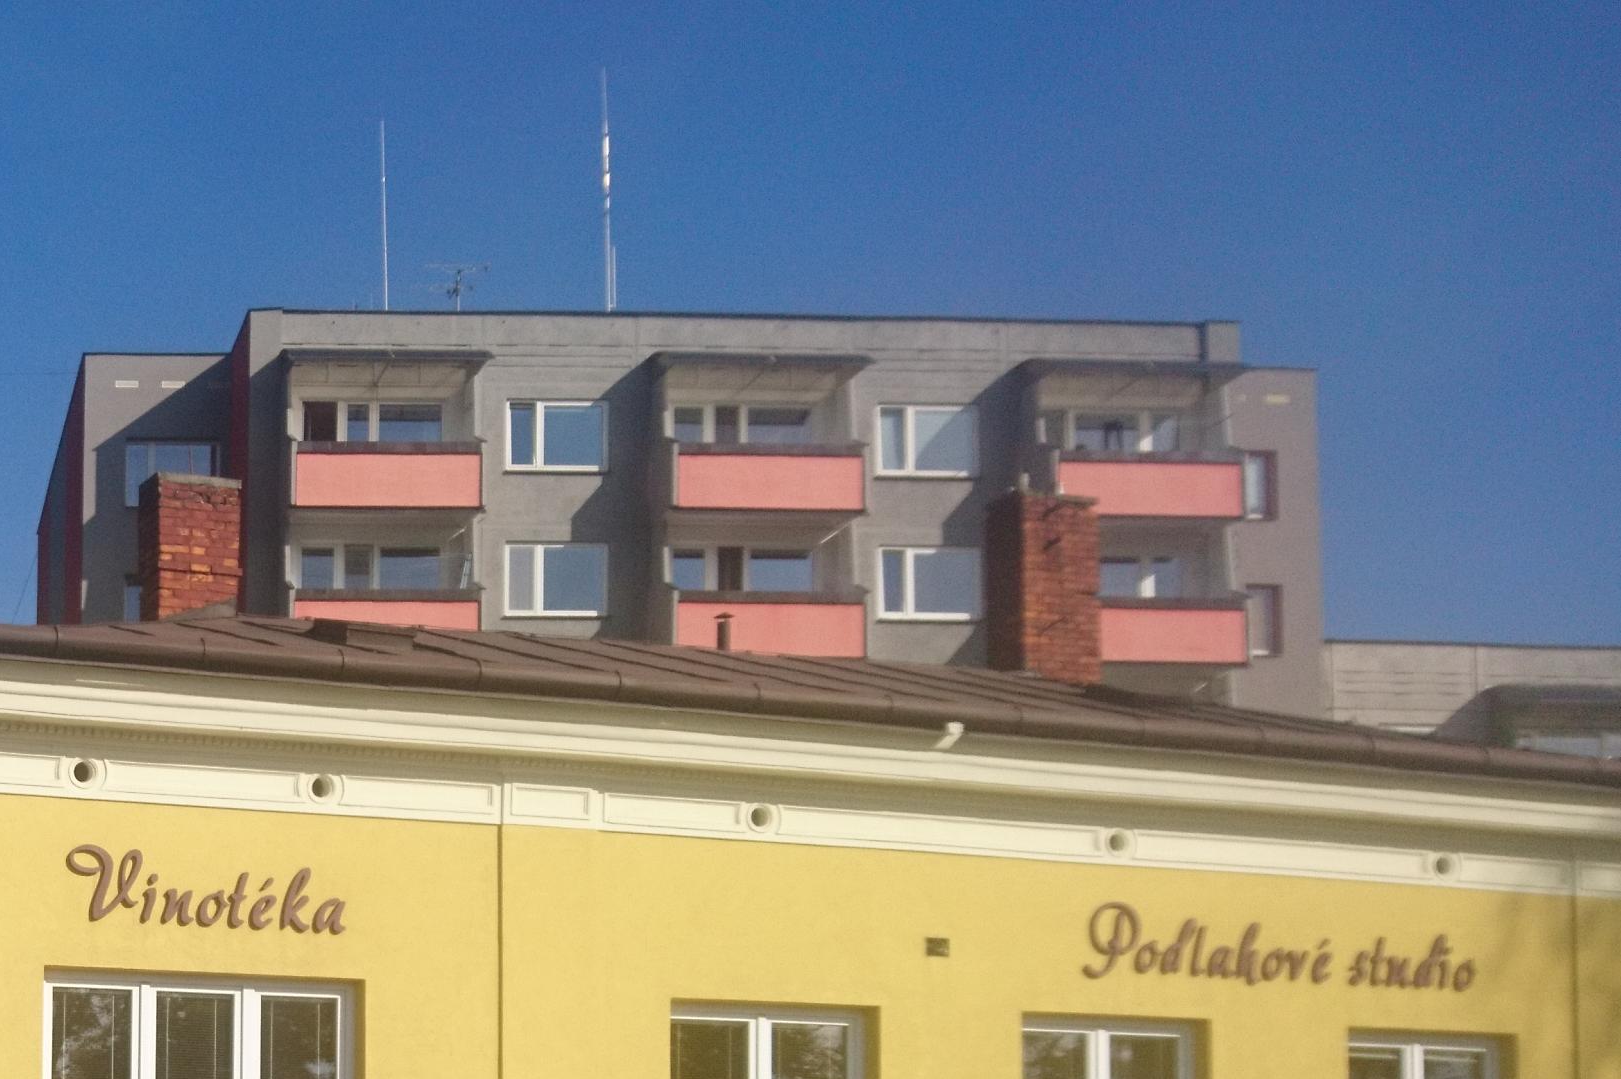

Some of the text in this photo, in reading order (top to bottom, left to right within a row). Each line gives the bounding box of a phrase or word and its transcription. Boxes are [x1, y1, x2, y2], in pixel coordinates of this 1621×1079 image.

[65, 843, 347, 936] Vinotéka
[1082, 901, 1476, 993] Podlahové studio
